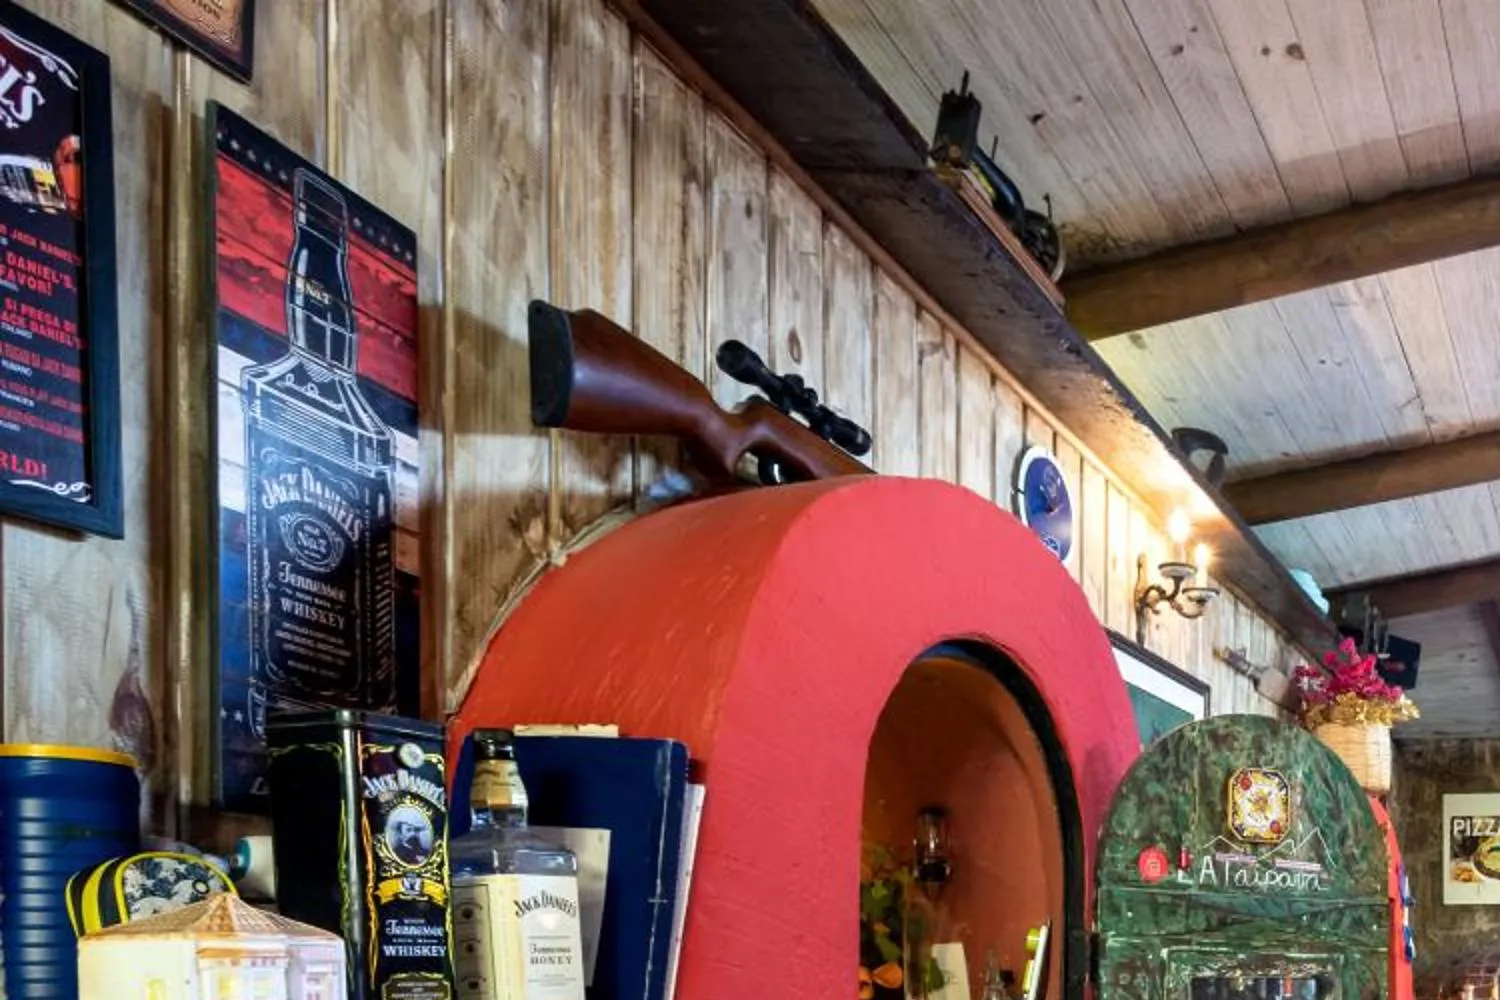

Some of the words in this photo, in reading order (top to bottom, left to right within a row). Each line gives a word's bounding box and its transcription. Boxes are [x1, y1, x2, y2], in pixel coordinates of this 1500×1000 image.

[279, 597, 346, 631] WHISKEY
[512, 894, 541, 918] JACK
[382, 944, 447, 957] WHISKEY
[529, 955, 573, 965] HONEY
